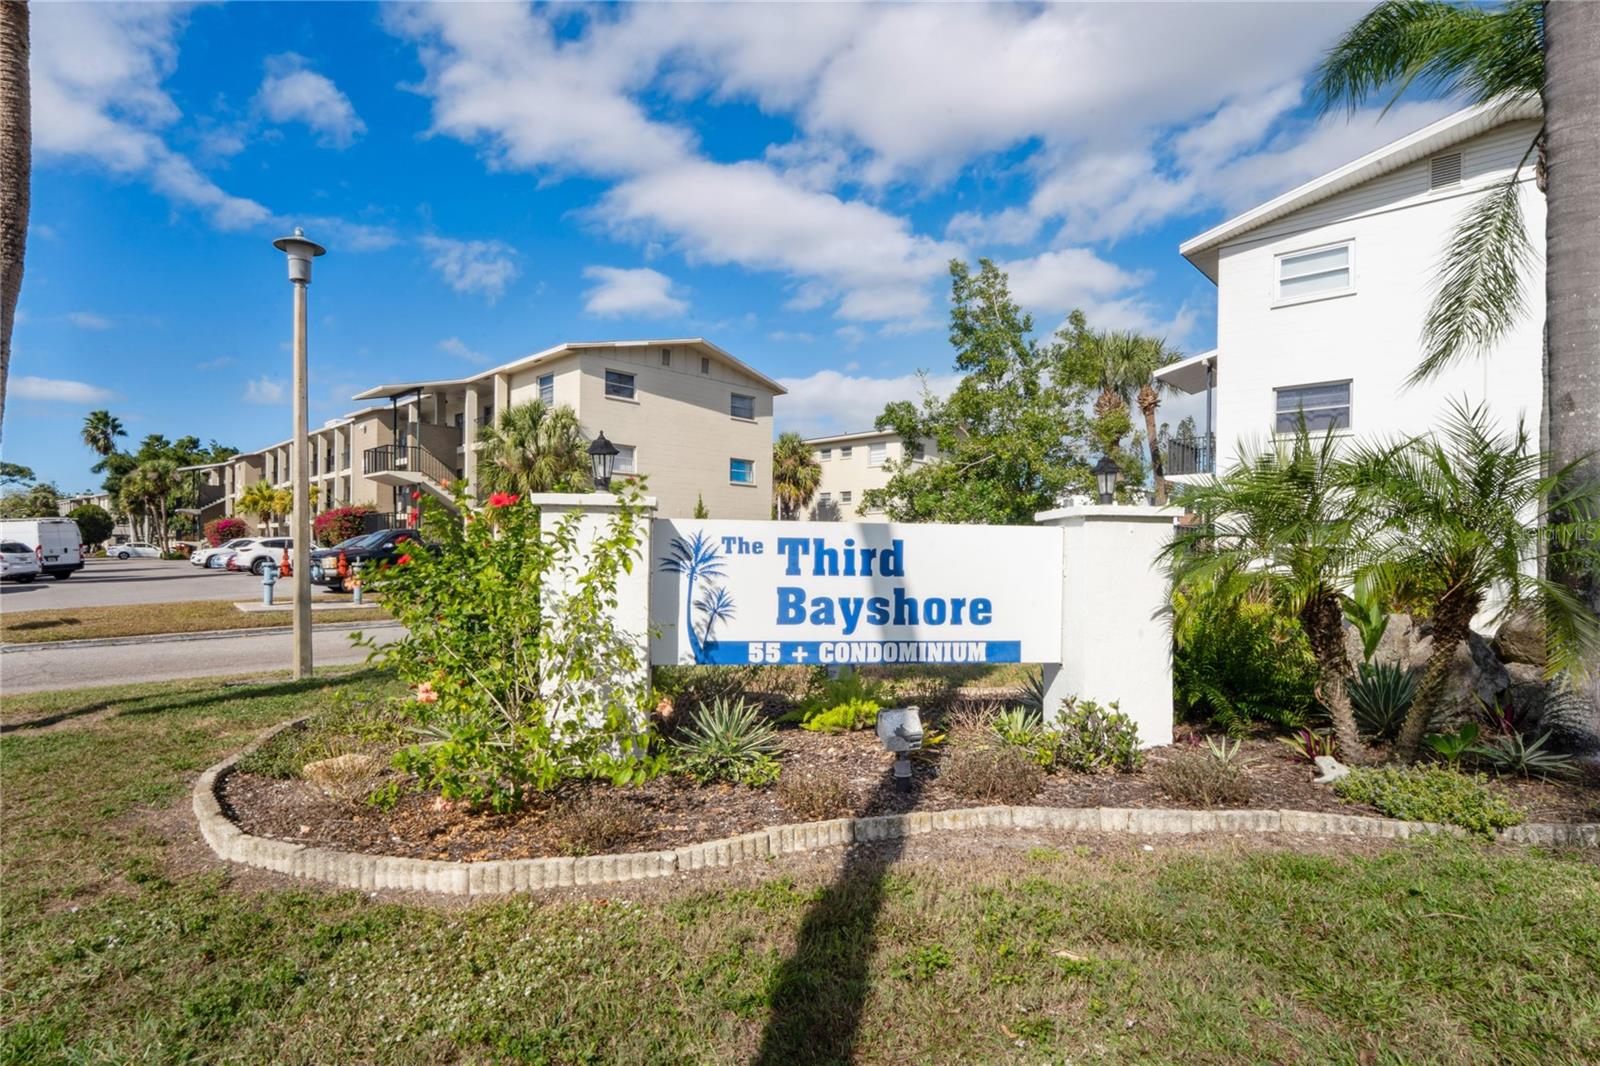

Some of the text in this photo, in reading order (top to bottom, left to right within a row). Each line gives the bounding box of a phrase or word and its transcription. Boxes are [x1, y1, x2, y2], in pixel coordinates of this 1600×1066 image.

[721, 536, 905, 577] The Third
[776, 586, 992, 635] Bayshore
[748, 642, 986, 663] 55 + CONDOMINIUM
